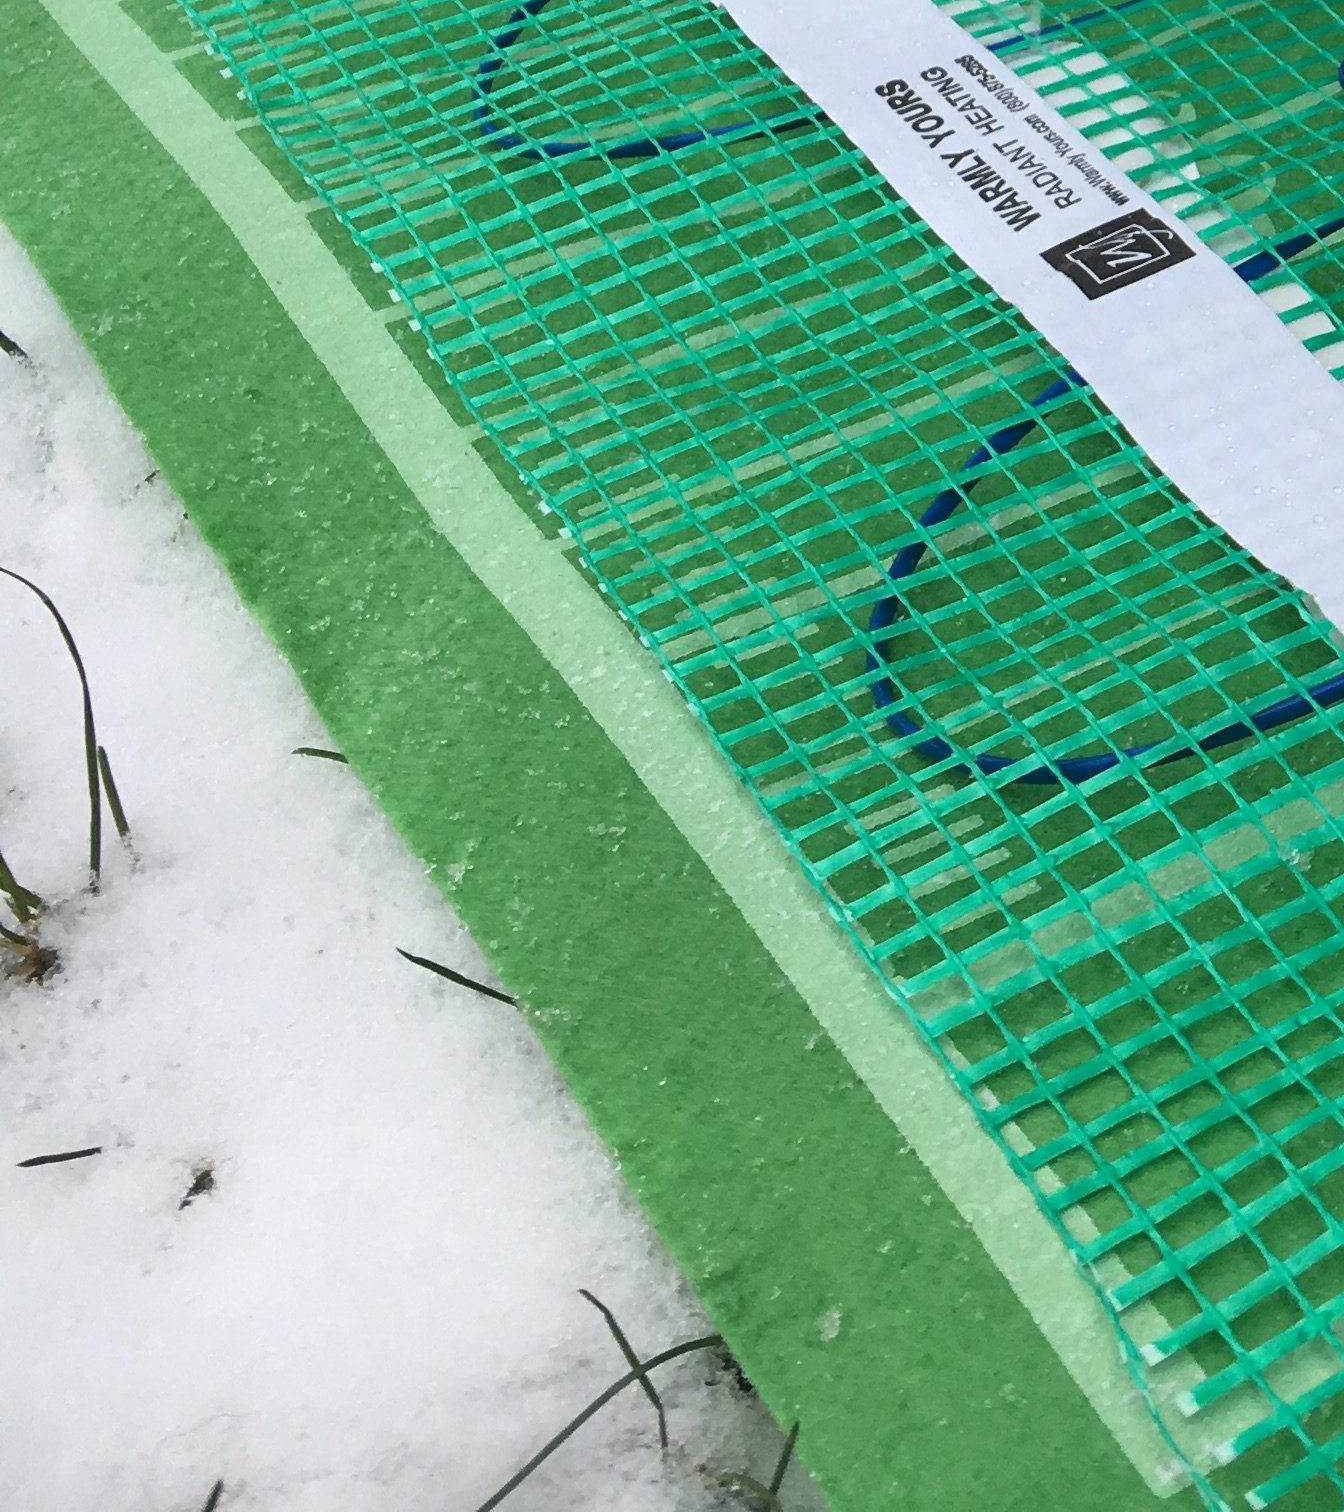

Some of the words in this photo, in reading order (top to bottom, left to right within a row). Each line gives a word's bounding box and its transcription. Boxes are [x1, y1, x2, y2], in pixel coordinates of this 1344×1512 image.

[875, 79, 955, 148] YOURS
[920, 67, 1004, 136] HEATING
[940, 149, 1041, 232] WARMLY
[993, 139, 1082, 209] RADIANT
